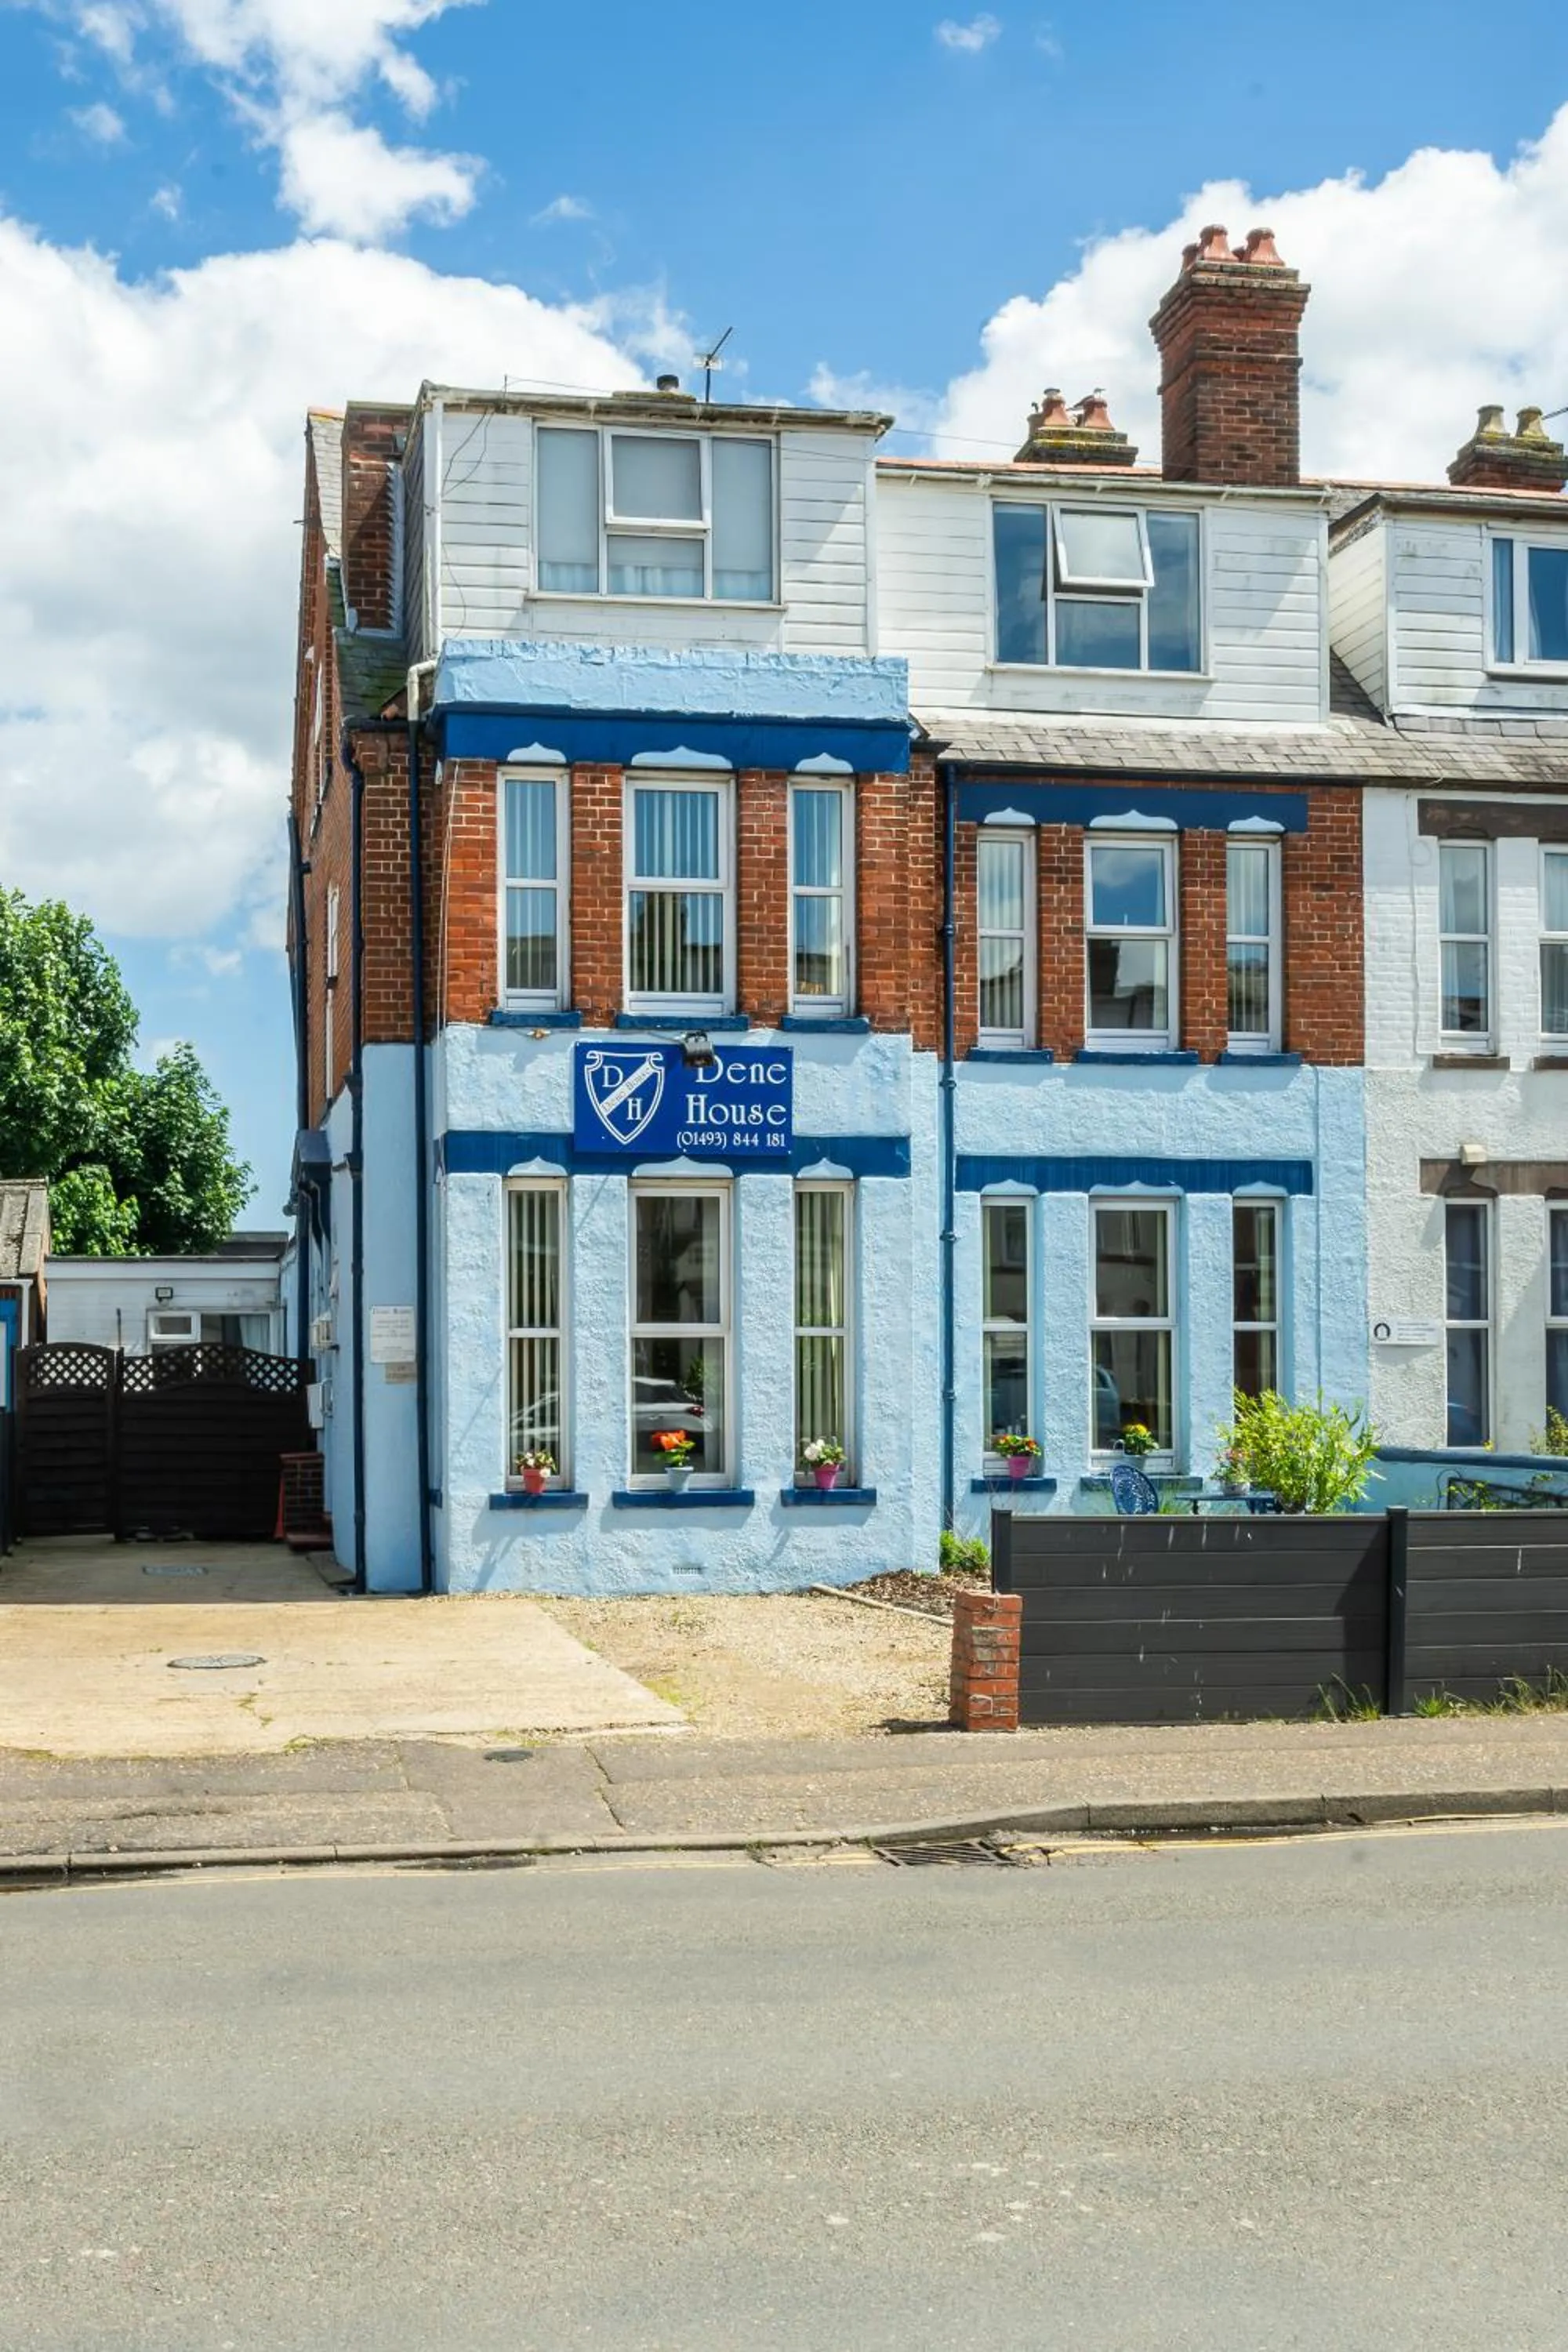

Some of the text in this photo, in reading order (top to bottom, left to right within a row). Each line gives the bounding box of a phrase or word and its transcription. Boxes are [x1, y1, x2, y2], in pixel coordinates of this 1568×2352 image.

[602, 1065, 624, 1087] D
[695, 1054, 787, 1084] Dene
[626, 1098, 644, 1120] H
[685, 1094, 787, 1125] House
[677, 1131, 786, 1149] (01493) 844 181
